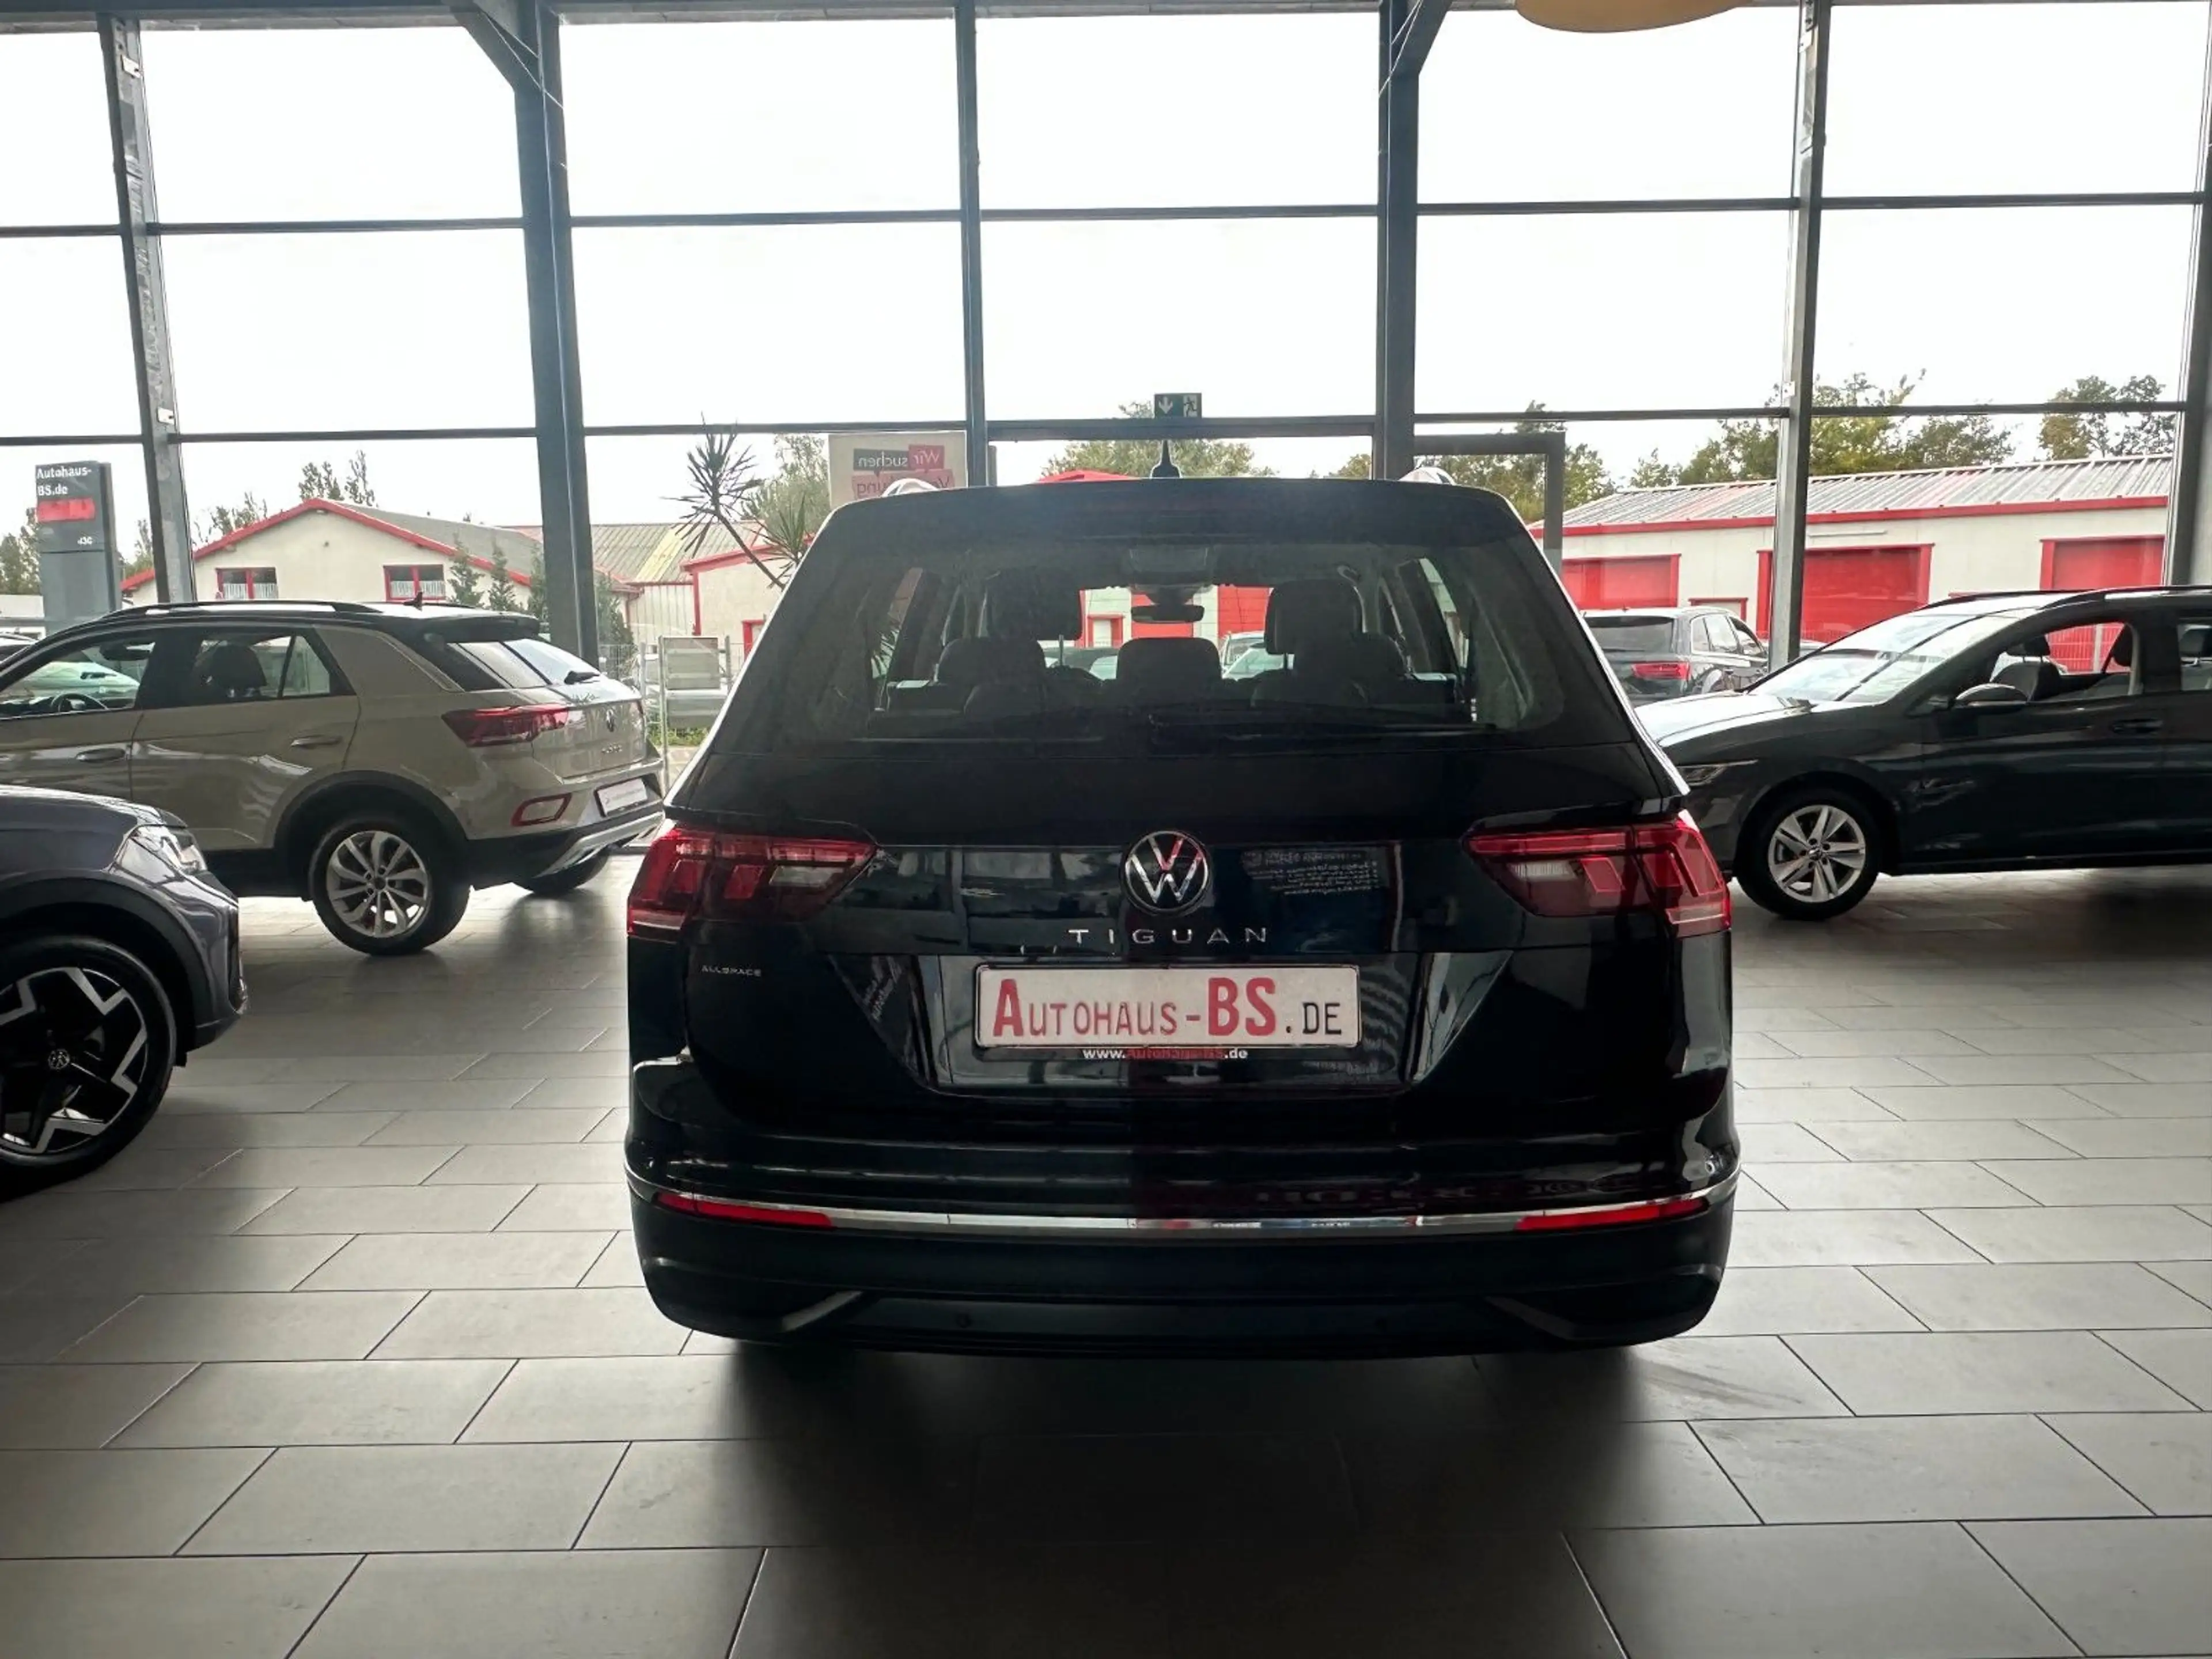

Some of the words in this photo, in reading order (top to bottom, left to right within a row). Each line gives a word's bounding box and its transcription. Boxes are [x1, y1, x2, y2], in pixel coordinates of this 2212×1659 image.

[36, 465, 92, 479] Autohaus-
[1129, 835, 1203, 903] VW
[1069, 929, 1266, 944] TIGUAN
